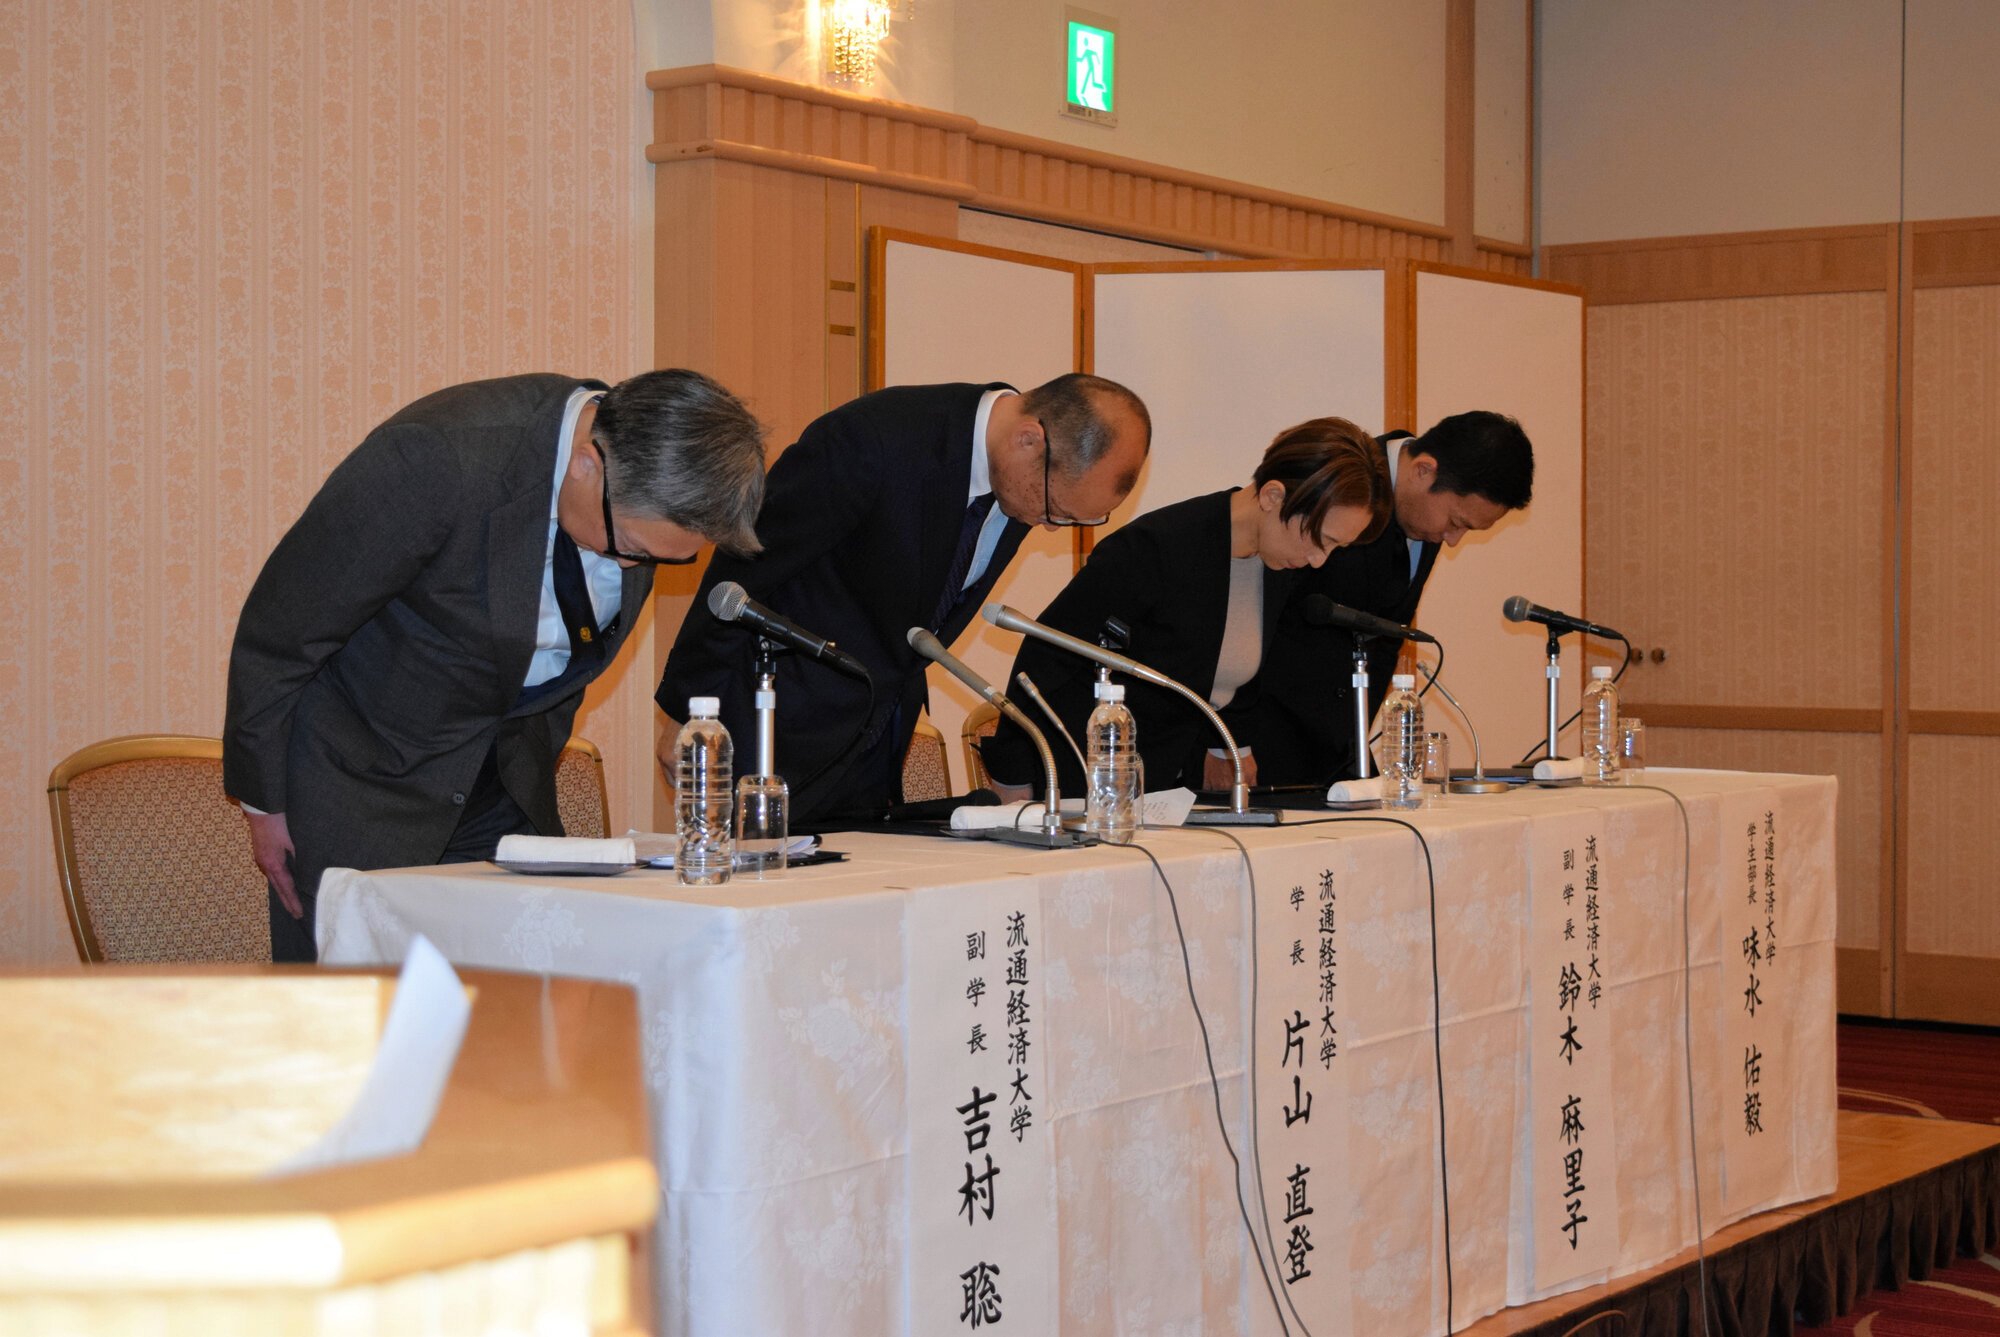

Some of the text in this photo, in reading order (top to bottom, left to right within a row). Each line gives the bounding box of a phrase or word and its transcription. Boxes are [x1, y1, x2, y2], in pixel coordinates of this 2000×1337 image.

[1318, 868, 1338, 1071] 流通経済大学
[1584, 834, 1602, 1010] 流通経済大学
[1741, 925, 1764, 1019] 味水
[1764, 810, 1777, 967] 流通経済大学
[1005, 910, 1033, 1144] 流通経済大学
[1281, 885, 1315, 1286] 学長 片山 直登
[1558, 848, 1589, 1251] 副学長 鈴木 麻里子
[1742, 1043, 1764, 1137] 佑毅
[955, 930, 1003, 1331] 副学長 吉村 聡
